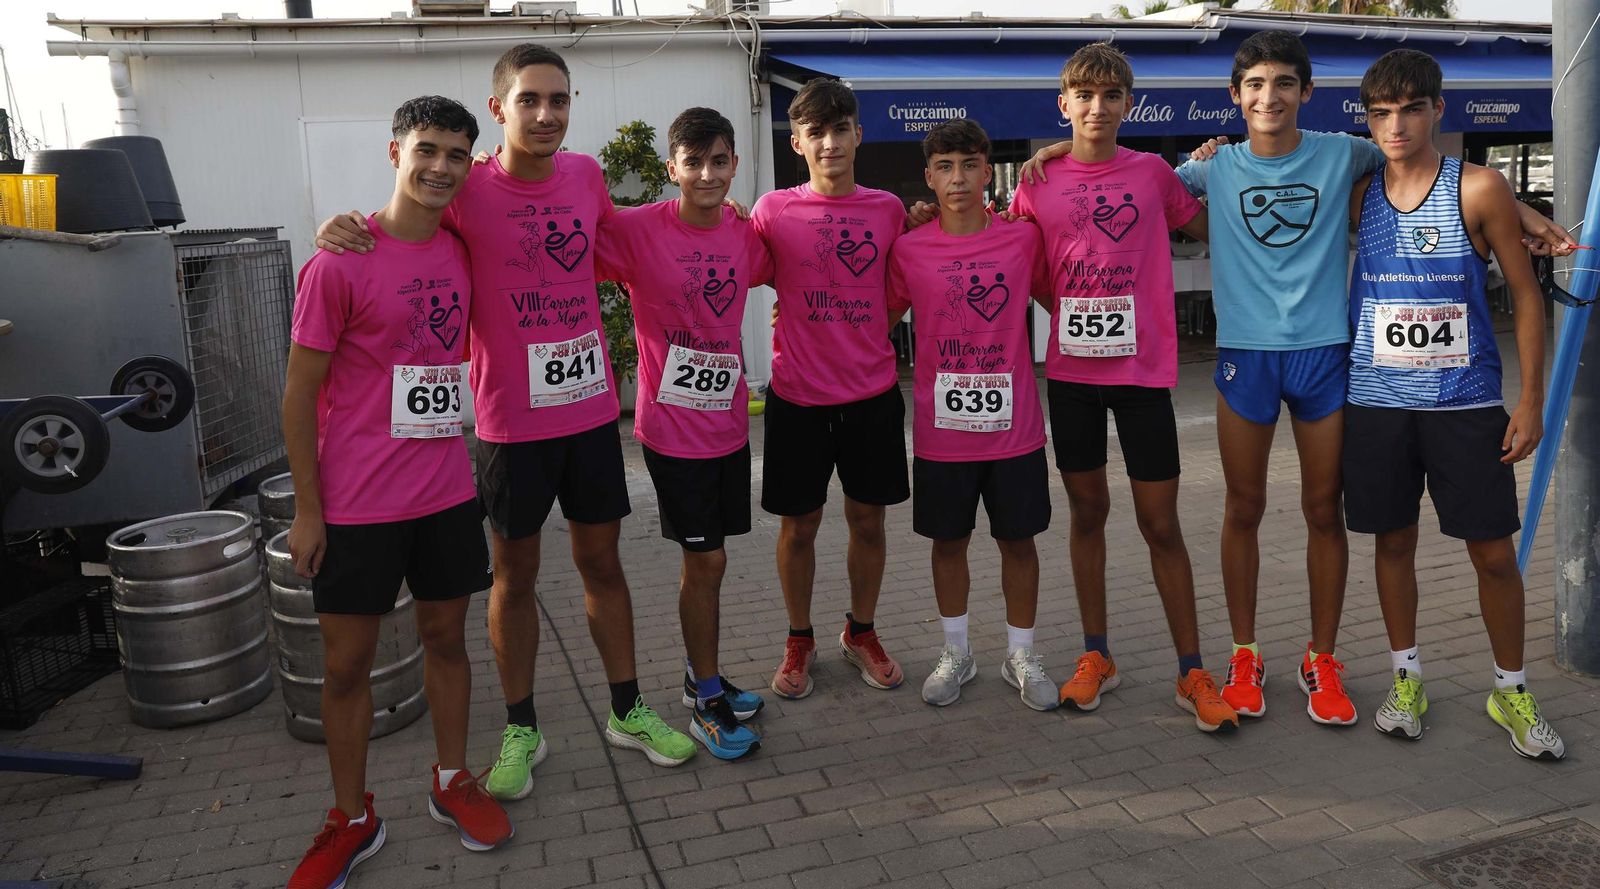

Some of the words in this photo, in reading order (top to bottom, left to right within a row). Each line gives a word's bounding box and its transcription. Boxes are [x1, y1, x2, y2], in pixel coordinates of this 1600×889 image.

[888, 103, 967, 120] Cruzcampo
[1187, 100, 1237, 126] lounge
[1465, 100, 1520, 115] Cruzcampo
[1473, 115, 1508, 124] ESPECIAL
[1062, 260, 1085, 277] VIII
[1086, 262, 1135, 277] Carrera
[1378, 272, 1424, 282] Atletismo
[1427, 272, 1465, 282] Linense
[1065, 278, 1077, 290] de
[1080, 279, 1091, 290] la
[1096, 277, 1135, 296] Mujer
[510, 291, 541, 313] VIII
[541, 294, 587, 311] Carrera
[803, 290, 827, 308] VIII
[829, 294, 873, 310] Carrera
[1074, 305, 1089, 313] POR
[1092, 305, 1102, 313] LA
[518, 314, 535, 328] de
[536, 313, 549, 327] la
[553, 309, 589, 331] Mujer
[808, 310, 821, 321] de
[823, 310, 834, 321] la
[839, 309, 872, 329] Mujer
[1067, 313, 1125, 338] 552
[1416, 314, 1428, 322] LA
[1386, 321, 1455, 348] 604
[551, 349, 570, 359] POR
[571, 347, 580, 356] LA
[936, 339, 960, 357] VIII
[961, 342, 1006, 356] Carrera
[544, 350, 596, 386] 841
[687, 357, 705, 367] POR
[706, 360, 716, 369] LA
[940, 358, 952, 370] de
[955, 357, 967, 369] la
[971, 355, 1007, 374] Mujer
[419, 375, 438, 384] POR
[440, 375, 449, 383] LA
[672, 364, 731, 392] 289
[953, 381, 970, 389] POR
[972, 381, 983, 389] LA
[407, 384, 461, 415] 693
[945, 389, 1003, 413] 639
